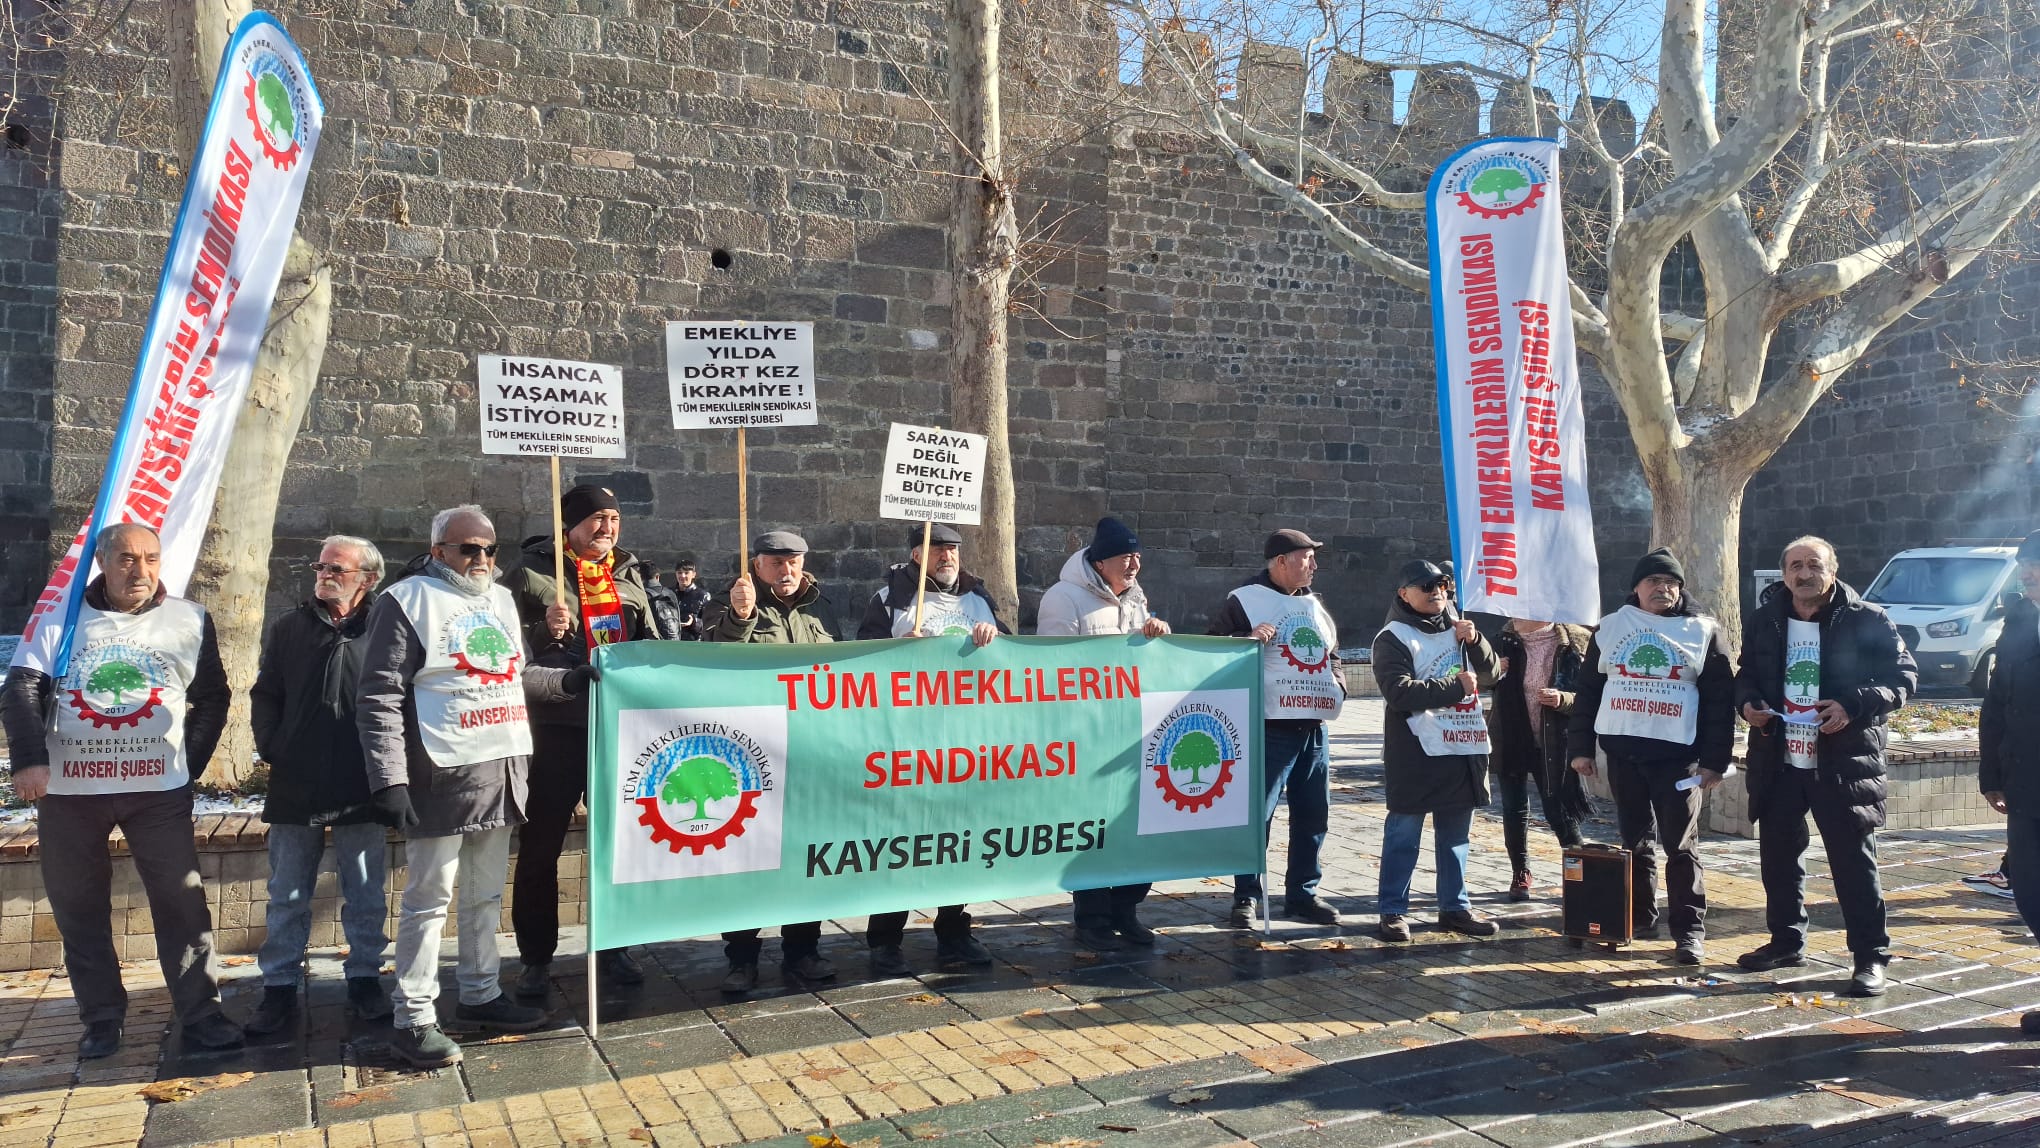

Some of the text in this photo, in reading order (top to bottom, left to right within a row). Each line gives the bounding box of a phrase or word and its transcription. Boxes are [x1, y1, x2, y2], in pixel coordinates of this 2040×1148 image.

[184, 137, 253, 327] SENDİKASI
[684, 325, 797, 340] EMEKLİYE
[707, 347, 776, 359] YILDA
[501, 359, 603, 384] İNSANCA
[684, 363, 799, 379] DÖRT KEZ
[497, 384, 608, 406] YAŞAMAK
[681, 383, 803, 398] İKRAMİYE !
[677, 400, 811, 413] TÜM EMEKLİLERİN SENDİKASI
[1459, 233, 1518, 597] TÜM EMEKLİLERİN SENDİKASI
[487, 404, 617, 429] İSTİYORUZ !
[709, 413, 783, 425] KAYSERİ ŞUBESİ
[487, 429, 620, 445] TÜM EMEKLİLERİN SENDİKASI
[906, 430, 969, 449] SARAYA
[519, 443, 592, 455] KAYSERİ ŞUBESİ
[913, 448, 960, 464] DEĞİL
[1520, 396, 1564, 511] KAYSERİ
[896, 463, 972, 482] EMEKLİYE
[902, 480, 962, 497] BÜTÇE !
[885, 494, 977, 511] TÜM EMEKLİLERİN SENDİKASI
[904, 508, 956, 520] KAYSERİ ŞUBESİ
[778, 664, 878, 711] TÜM
[1280, 693, 1313, 708] KAYSERİ
[1611, 696, 1683, 718] KAYSERİ ŞUBESİ
[105, 706, 126, 714] 2017
[460, 701, 510, 729] KAYSERİ
[60, 737, 168, 746] TÜM EMEKLİLERİN
[1146, 702, 1242, 770] TÜM EMEKLİLERİN SENDİKASI
[80, 746, 148, 754] SENDİKASI
[62, 754, 165, 781] KAYSERİ ŞUBESİ
[624, 721, 773, 803] TÜM EMEKLİLERİN SENDİKASI
[690, 824, 709, 832] 2017
